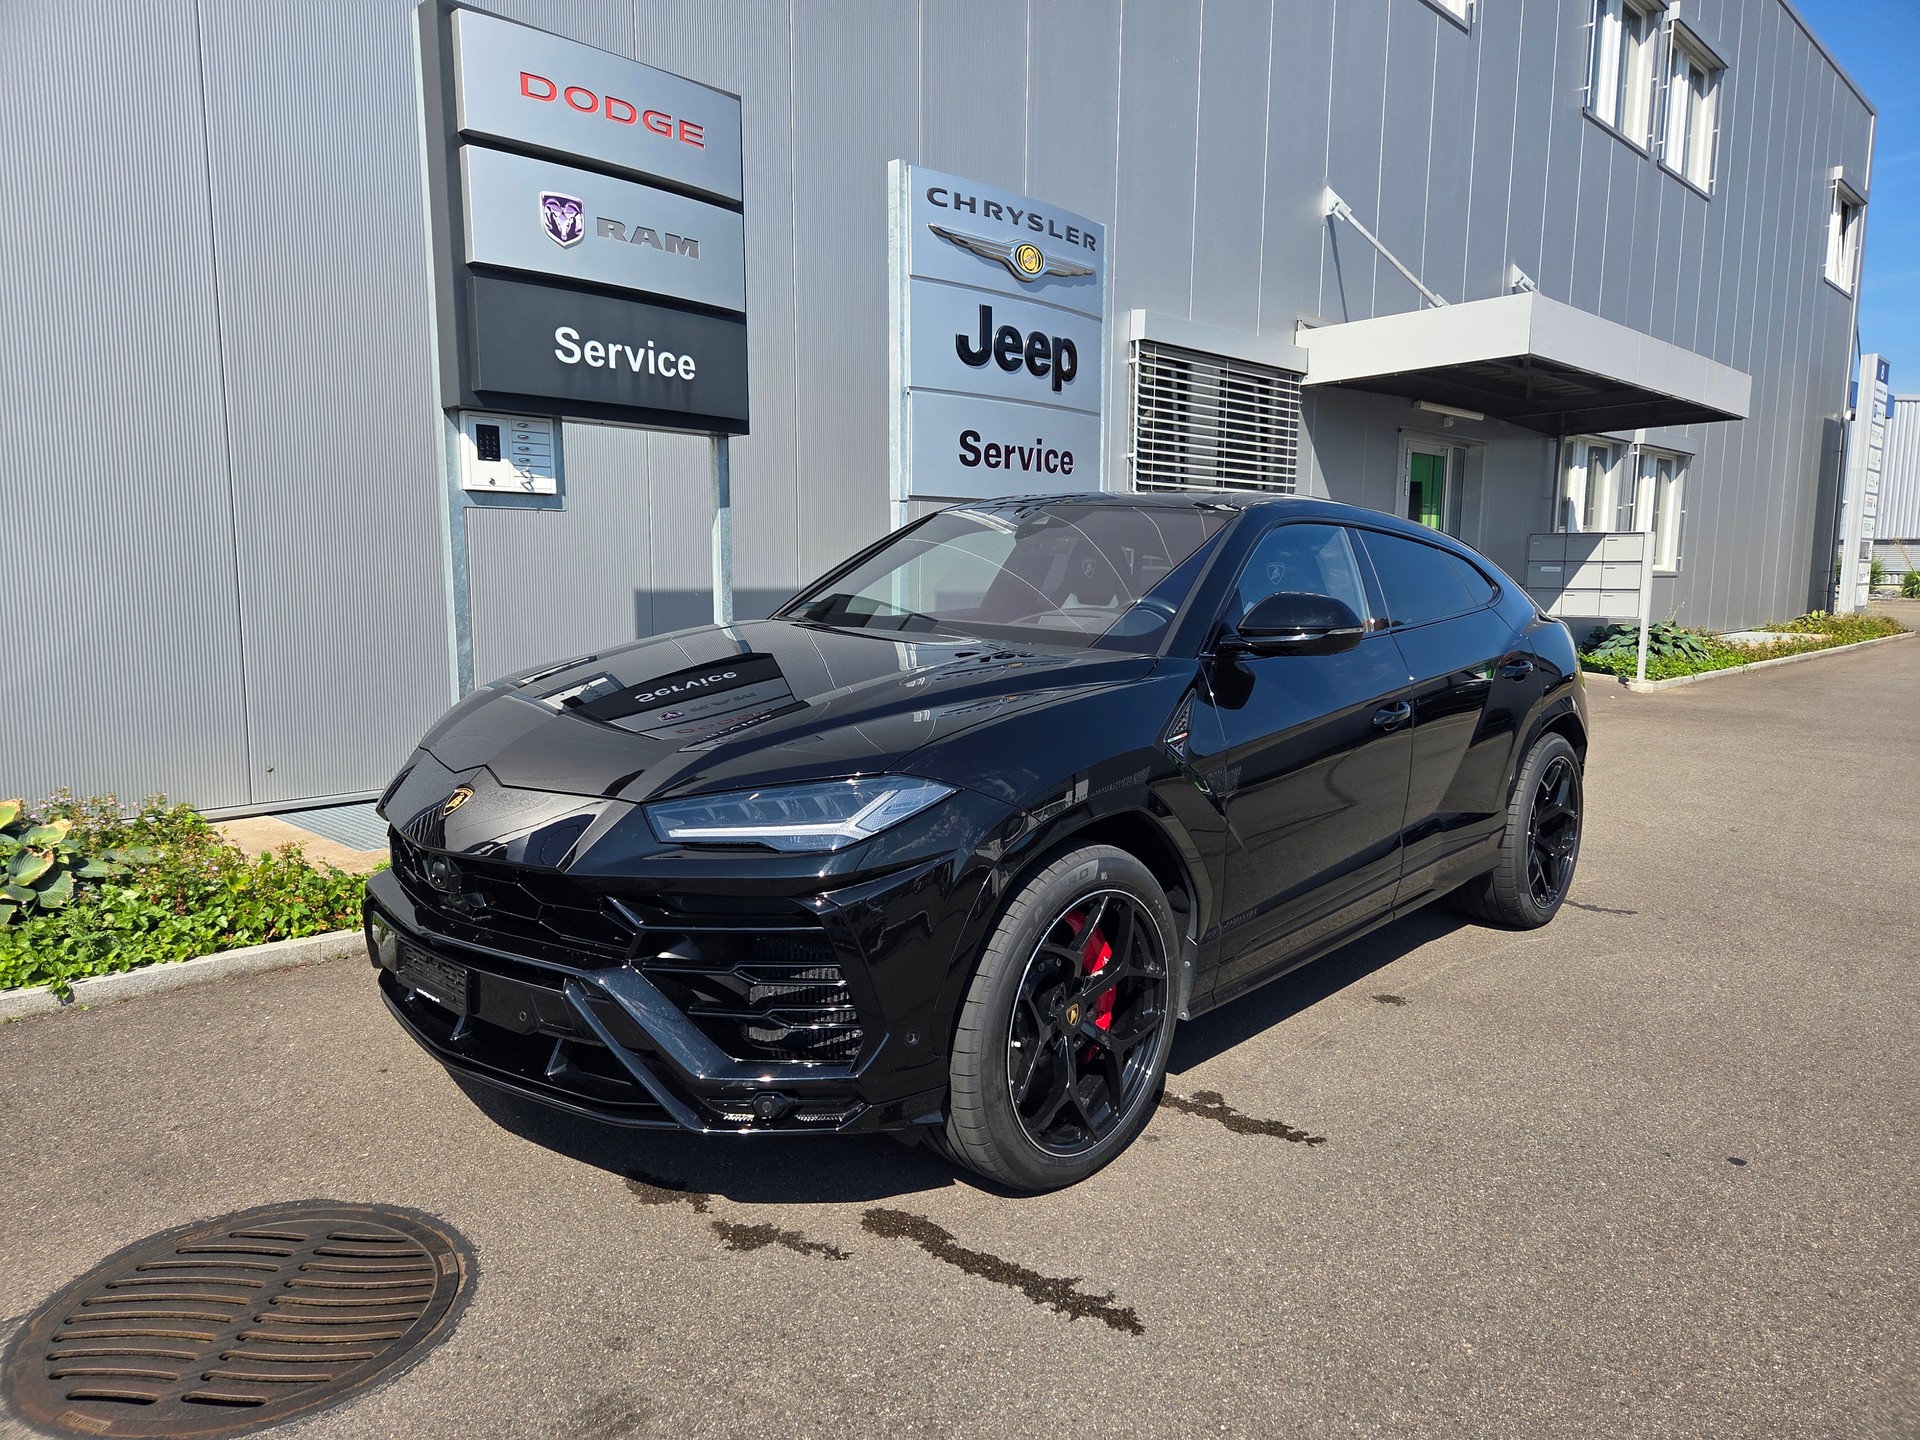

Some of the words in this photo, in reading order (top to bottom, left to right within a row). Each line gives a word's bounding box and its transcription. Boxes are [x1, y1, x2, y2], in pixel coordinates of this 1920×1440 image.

[519, 71, 706, 150] DODGE
[596, 216, 701, 260] RAM
[926, 186, 1098, 251] CHRYSLER
[554, 325, 697, 381] Service
[955, 303, 1078, 391] Jeep
[958, 429, 1074, 476] Service
